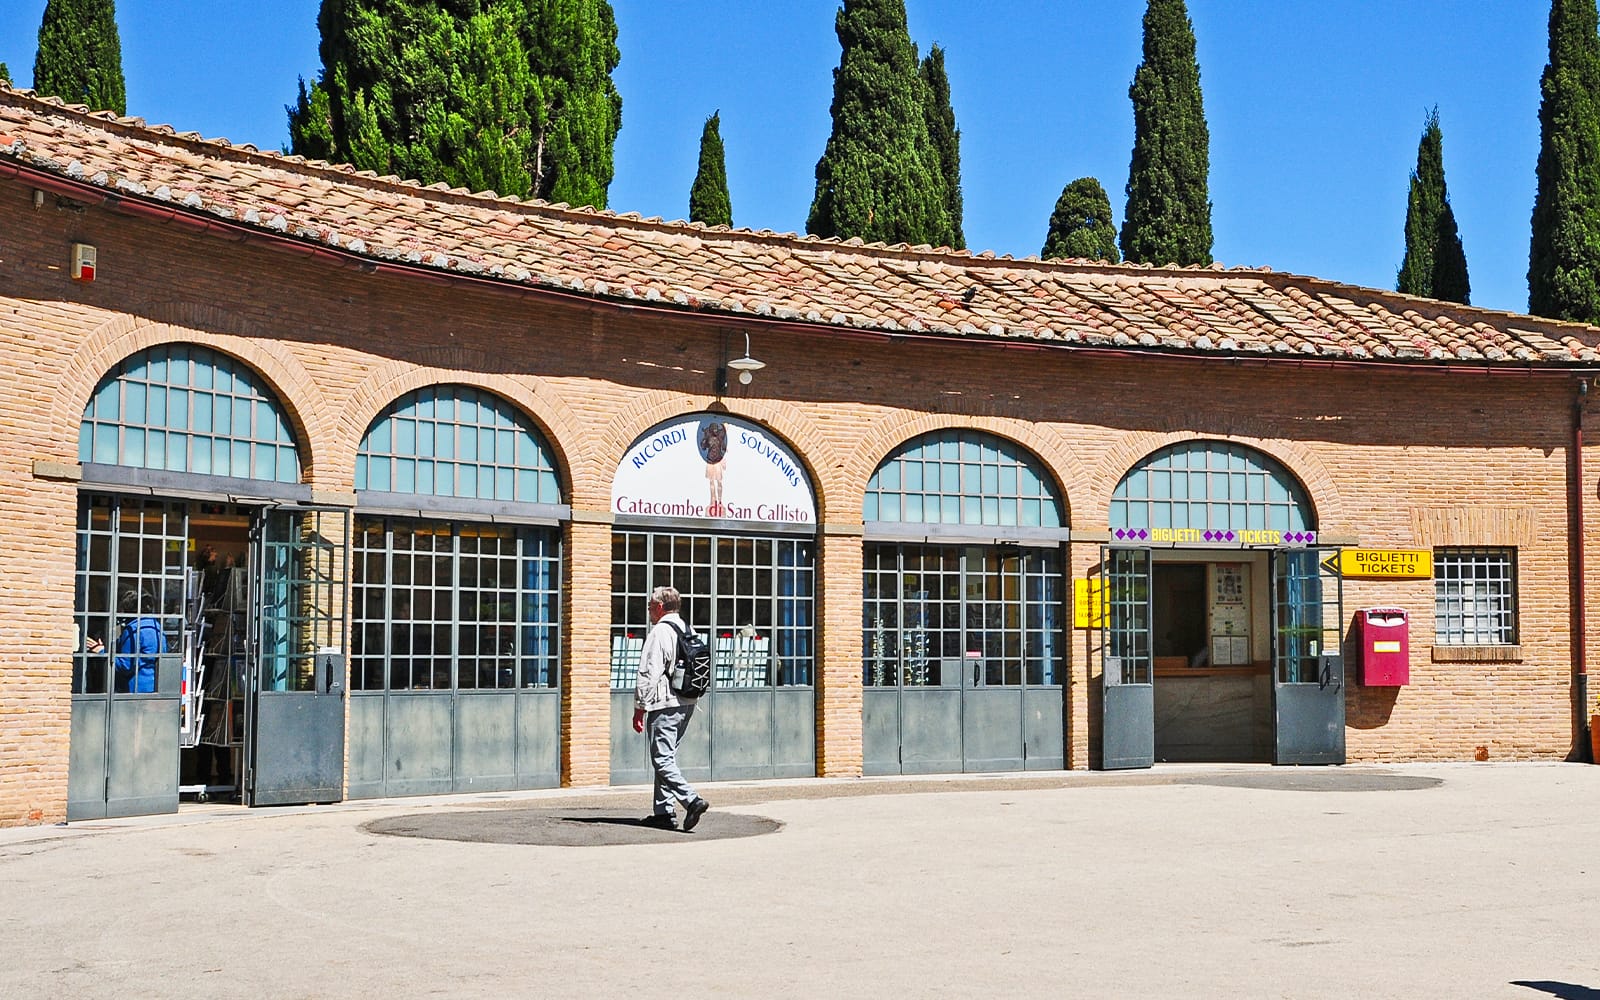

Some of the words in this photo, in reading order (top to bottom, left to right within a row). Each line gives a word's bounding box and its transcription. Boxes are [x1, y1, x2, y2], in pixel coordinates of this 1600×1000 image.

[632, 428, 687, 469] RICORDI
[740, 432, 800, 487] SOUVENIRS
[616, 496, 704, 517] Catacombe
[709, 500, 722, 517] di
[727, 502, 752, 519] San
[757, 504, 808, 522] Callisto
[1151, 528, 1200, 542] BIGLIETTI
[1238, 530, 1281, 543] TICKETS
[1356, 553, 1419, 563] BIGLIETTI
[1360, 563, 1415, 574] TICKETS
